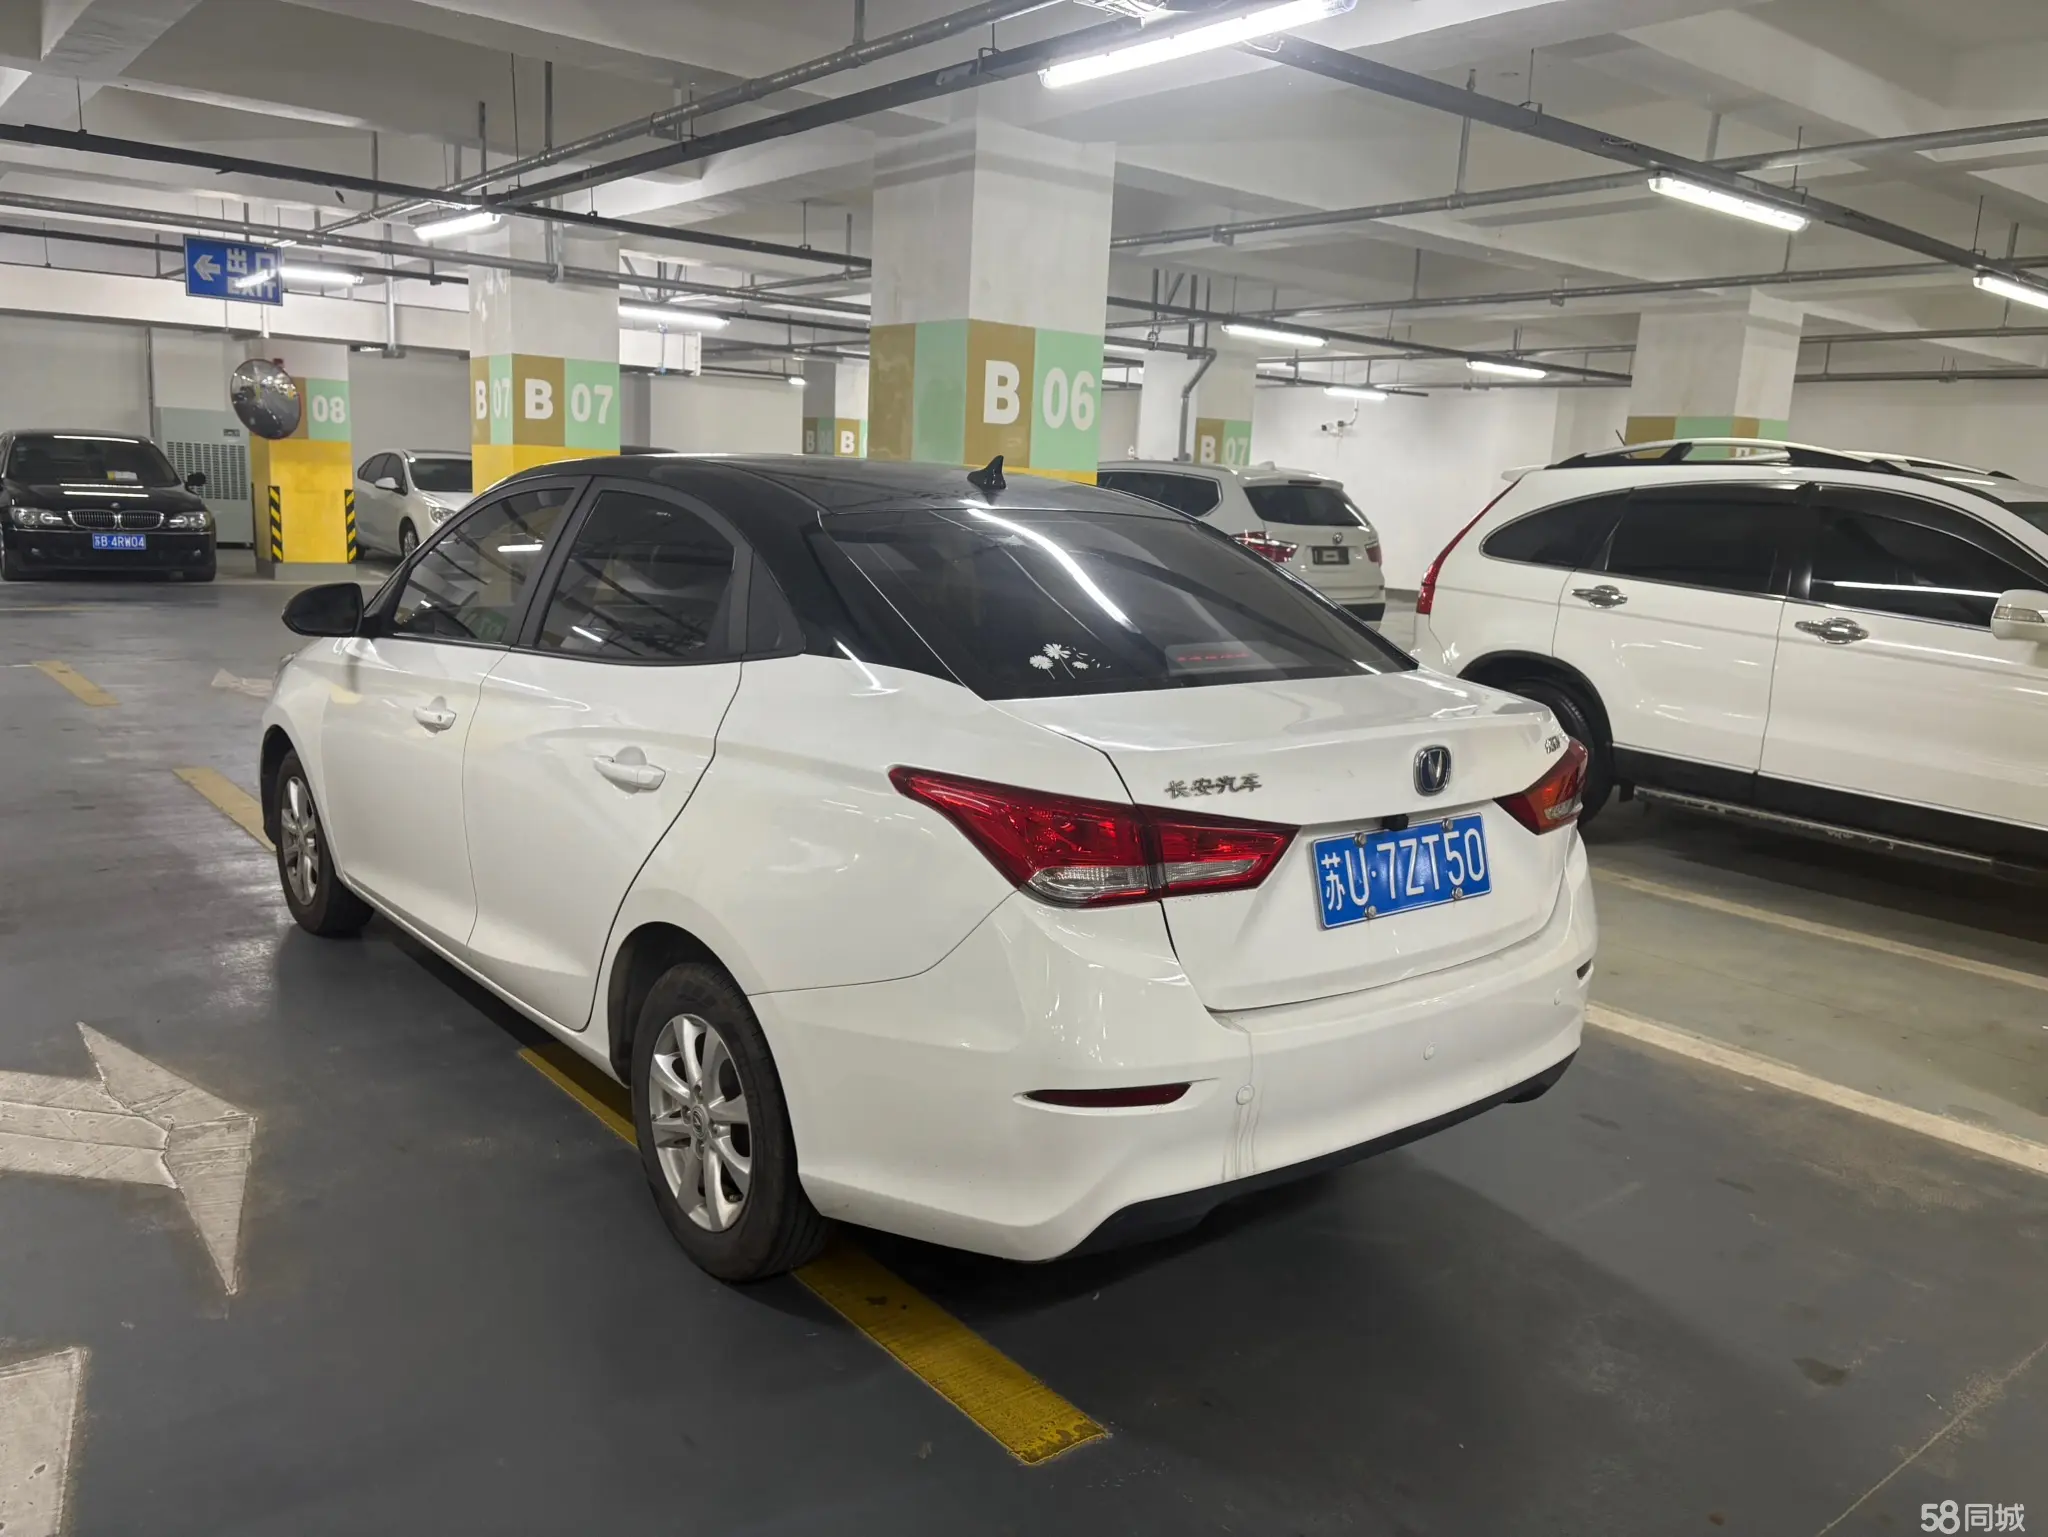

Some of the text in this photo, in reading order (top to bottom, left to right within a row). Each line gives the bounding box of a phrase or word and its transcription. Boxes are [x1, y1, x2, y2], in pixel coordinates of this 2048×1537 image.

[226, 247, 277, 279] 出口
[312, 394, 346, 424] 08
[475, 377, 512, 420] B 07
[524, 377, 613, 425] B 07
[983, 359, 1095, 432] B 06
[805, 430, 815, 453] B
[840, 430, 855, 454] B
[1200, 434, 1248, 467] B 07
[1164, 773, 1262, 800] 长安汽车
